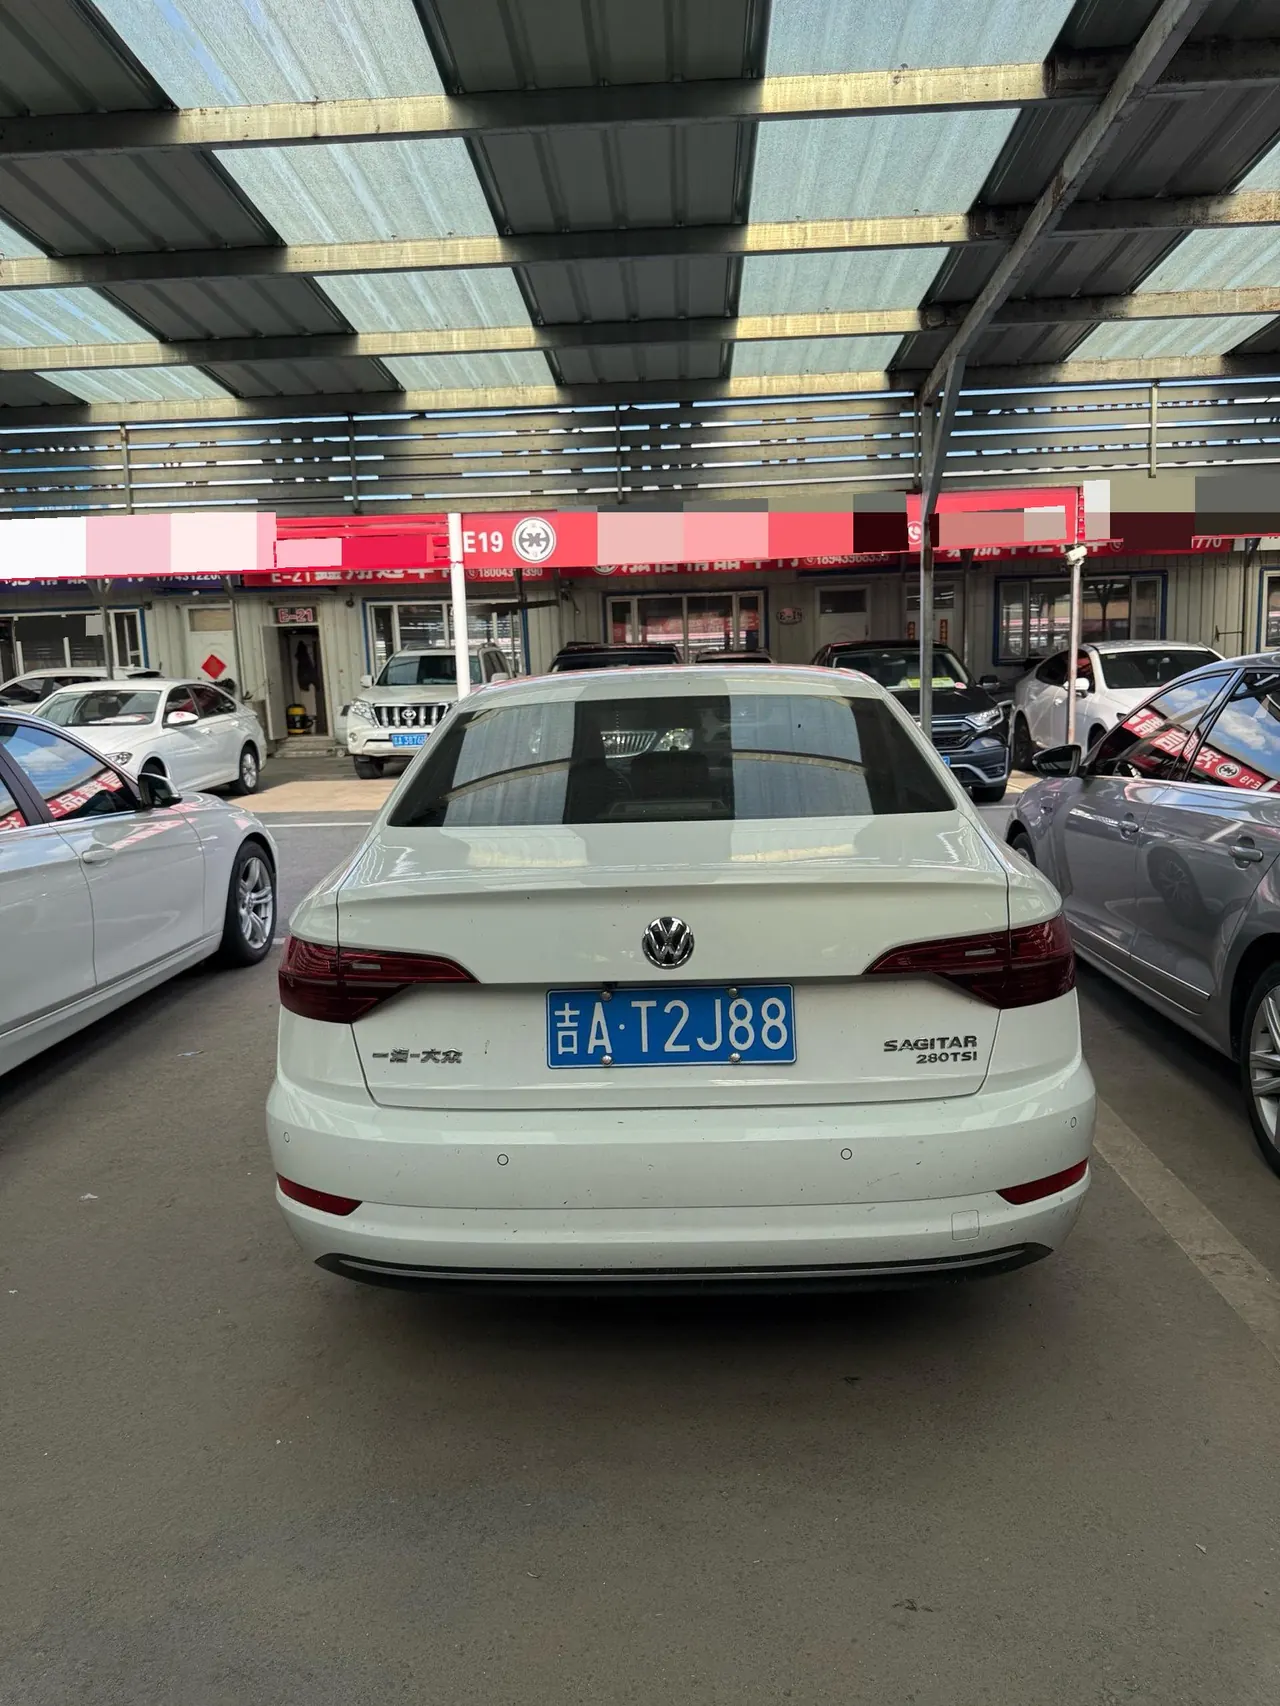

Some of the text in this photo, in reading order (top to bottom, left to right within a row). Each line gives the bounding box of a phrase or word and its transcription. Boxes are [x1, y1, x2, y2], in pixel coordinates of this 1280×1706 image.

[463, 531, 503, 552] E19
[278, 608, 313, 623] E-21
[883, 1035, 978, 1052] SAGITAR
[916, 1051, 978, 1064] 280TSI
